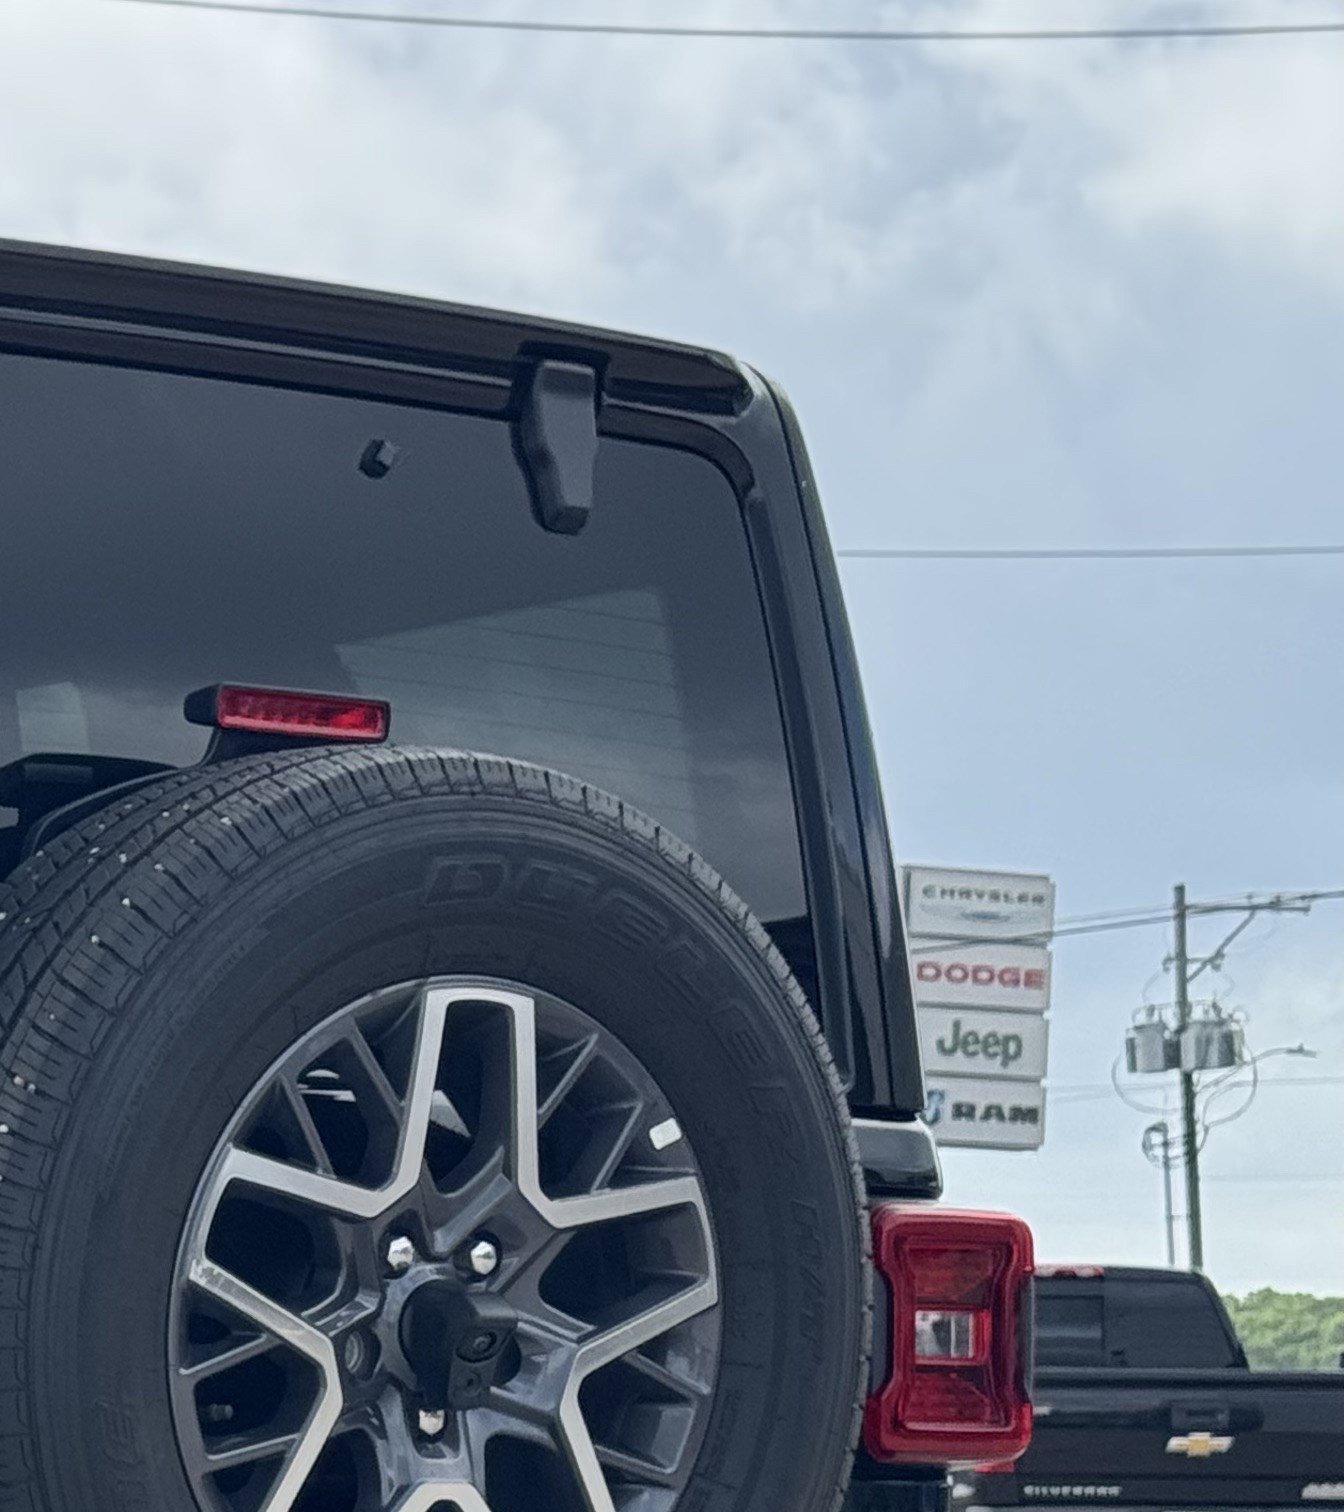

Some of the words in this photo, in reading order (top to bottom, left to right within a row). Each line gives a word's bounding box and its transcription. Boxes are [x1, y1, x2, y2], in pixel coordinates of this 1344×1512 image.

[922, 883, 1045, 905] CHRYSLER
[916, 960, 1045, 991] DODGE
[936, 1018, 1023, 1068] Jeep
[952, 1101, 1040, 1125] RAM
